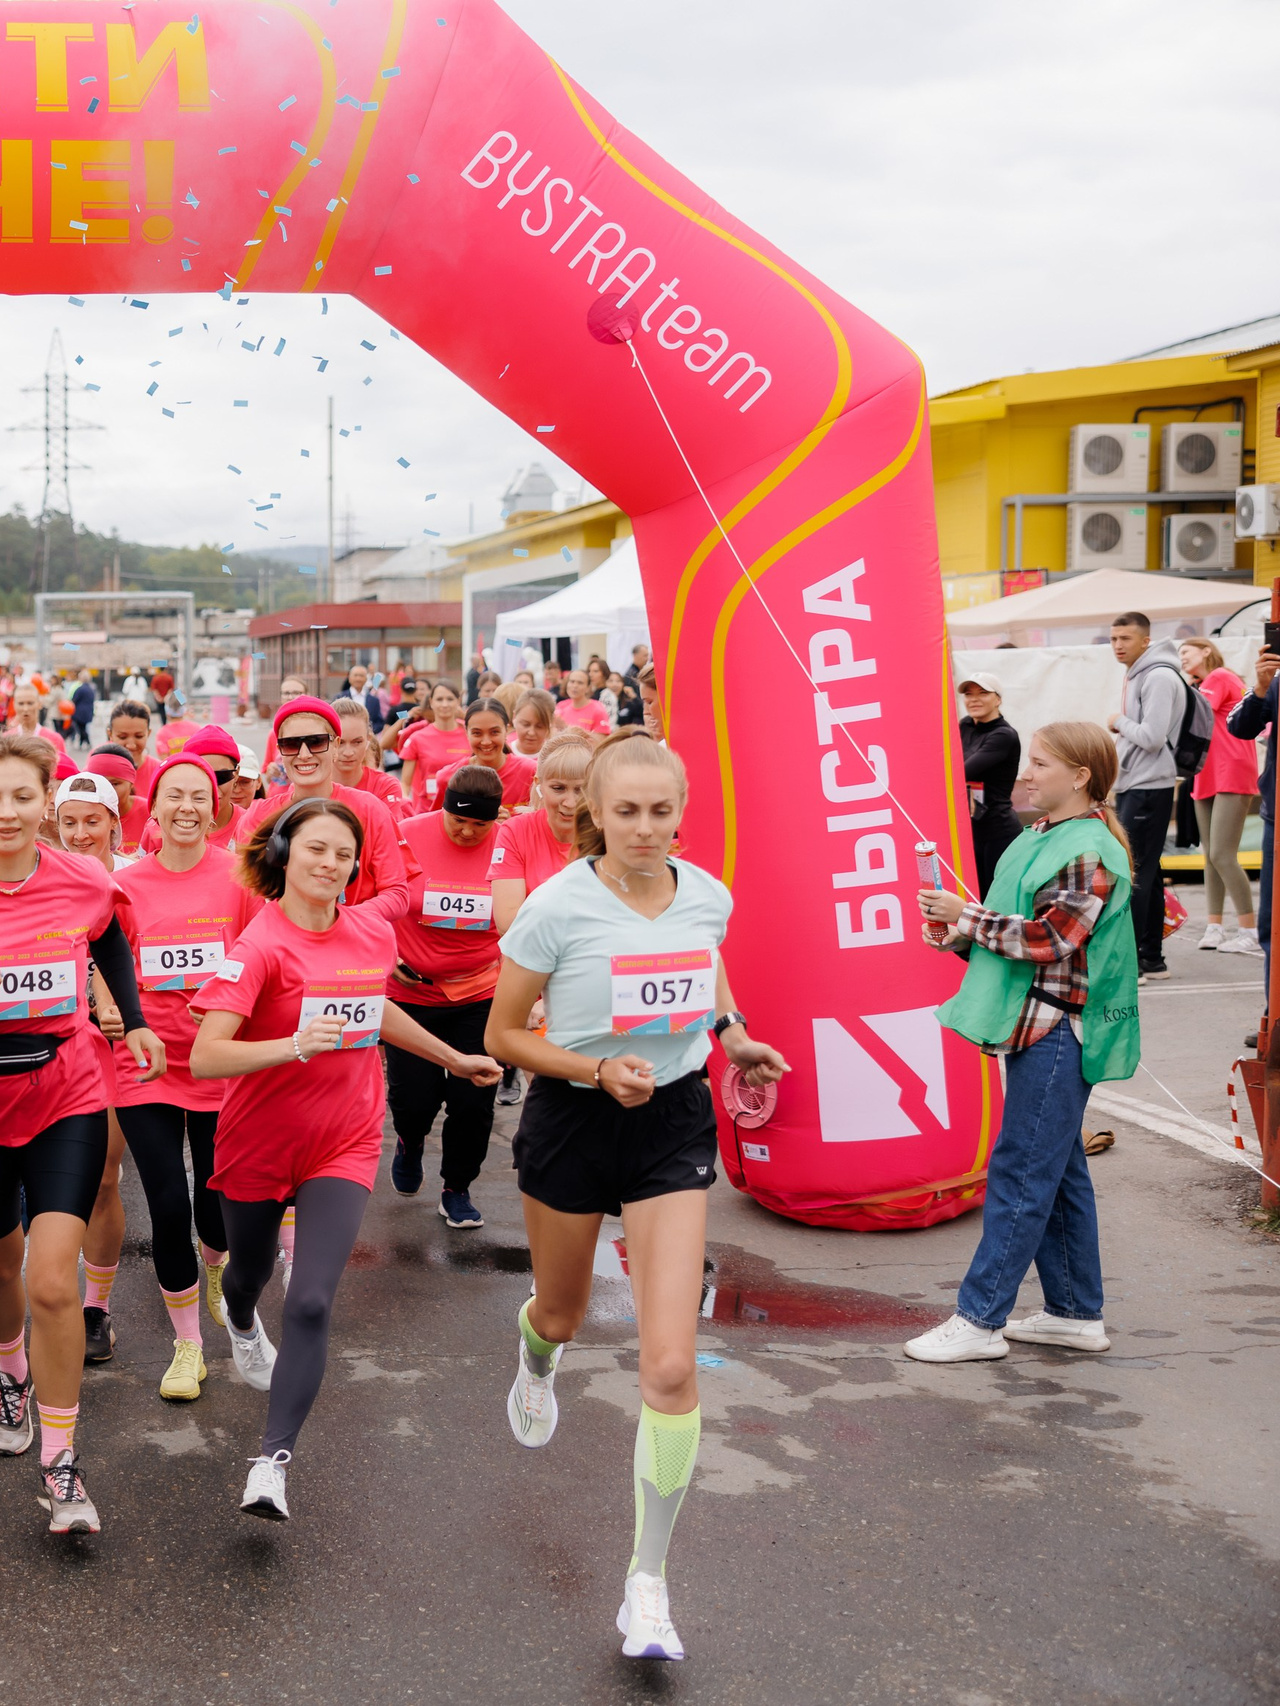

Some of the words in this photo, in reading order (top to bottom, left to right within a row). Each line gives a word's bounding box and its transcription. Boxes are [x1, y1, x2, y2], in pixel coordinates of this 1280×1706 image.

[460, 130, 656, 310] BYSTRA
[641, 277, 772, 414] team
[802, 557, 905, 949] БЫСТРА
[440, 896, 475, 913] 045
[160, 948, 204, 969] 035
[2, 969, 53, 994] 048
[640, 978, 693, 1005] 057
[323, 1002, 366, 1024] 056
